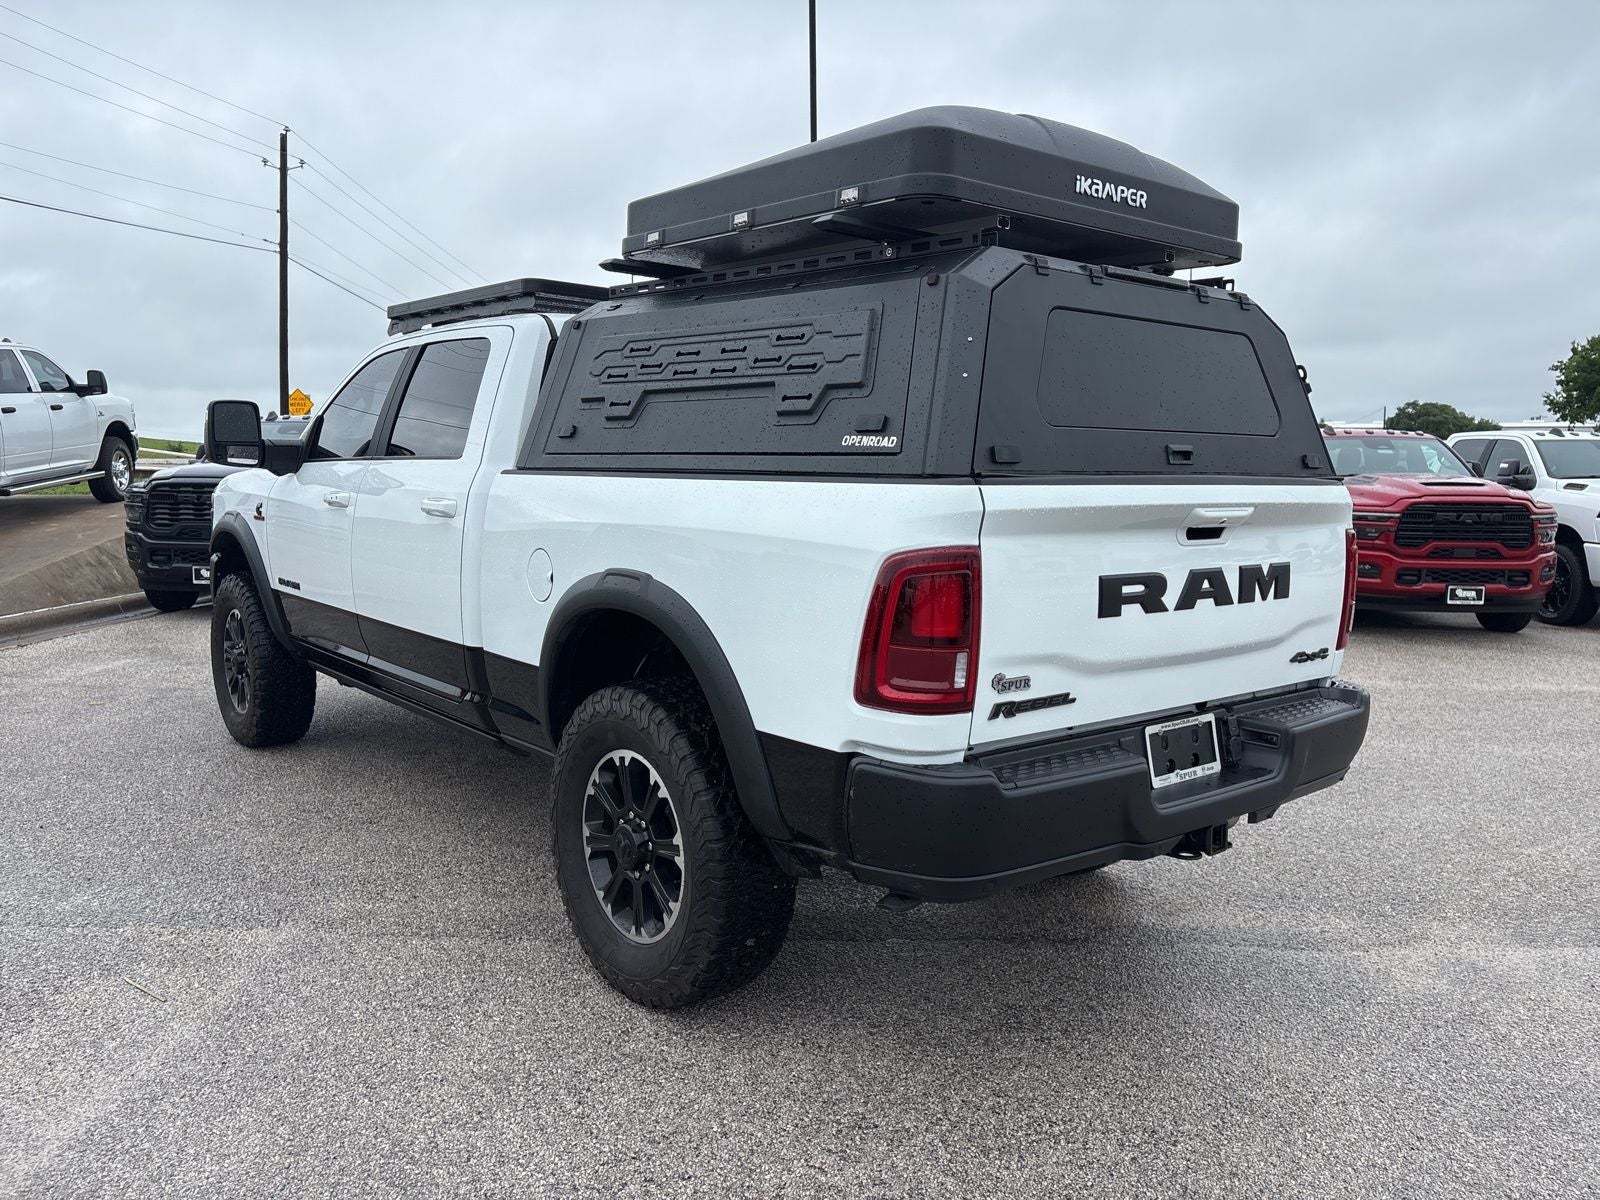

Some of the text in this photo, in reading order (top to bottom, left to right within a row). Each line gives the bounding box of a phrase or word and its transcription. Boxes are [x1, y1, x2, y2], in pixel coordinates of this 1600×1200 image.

[841, 435, 898, 447] OPENROAD
[1436, 512, 1502, 522] RAM
[1098, 562, 1290, 619] RAM
[1001, 678, 1031, 692] SPUR
[987, 692, 1076, 721] REBEL
[1179, 770, 1198, 781] SPUR
